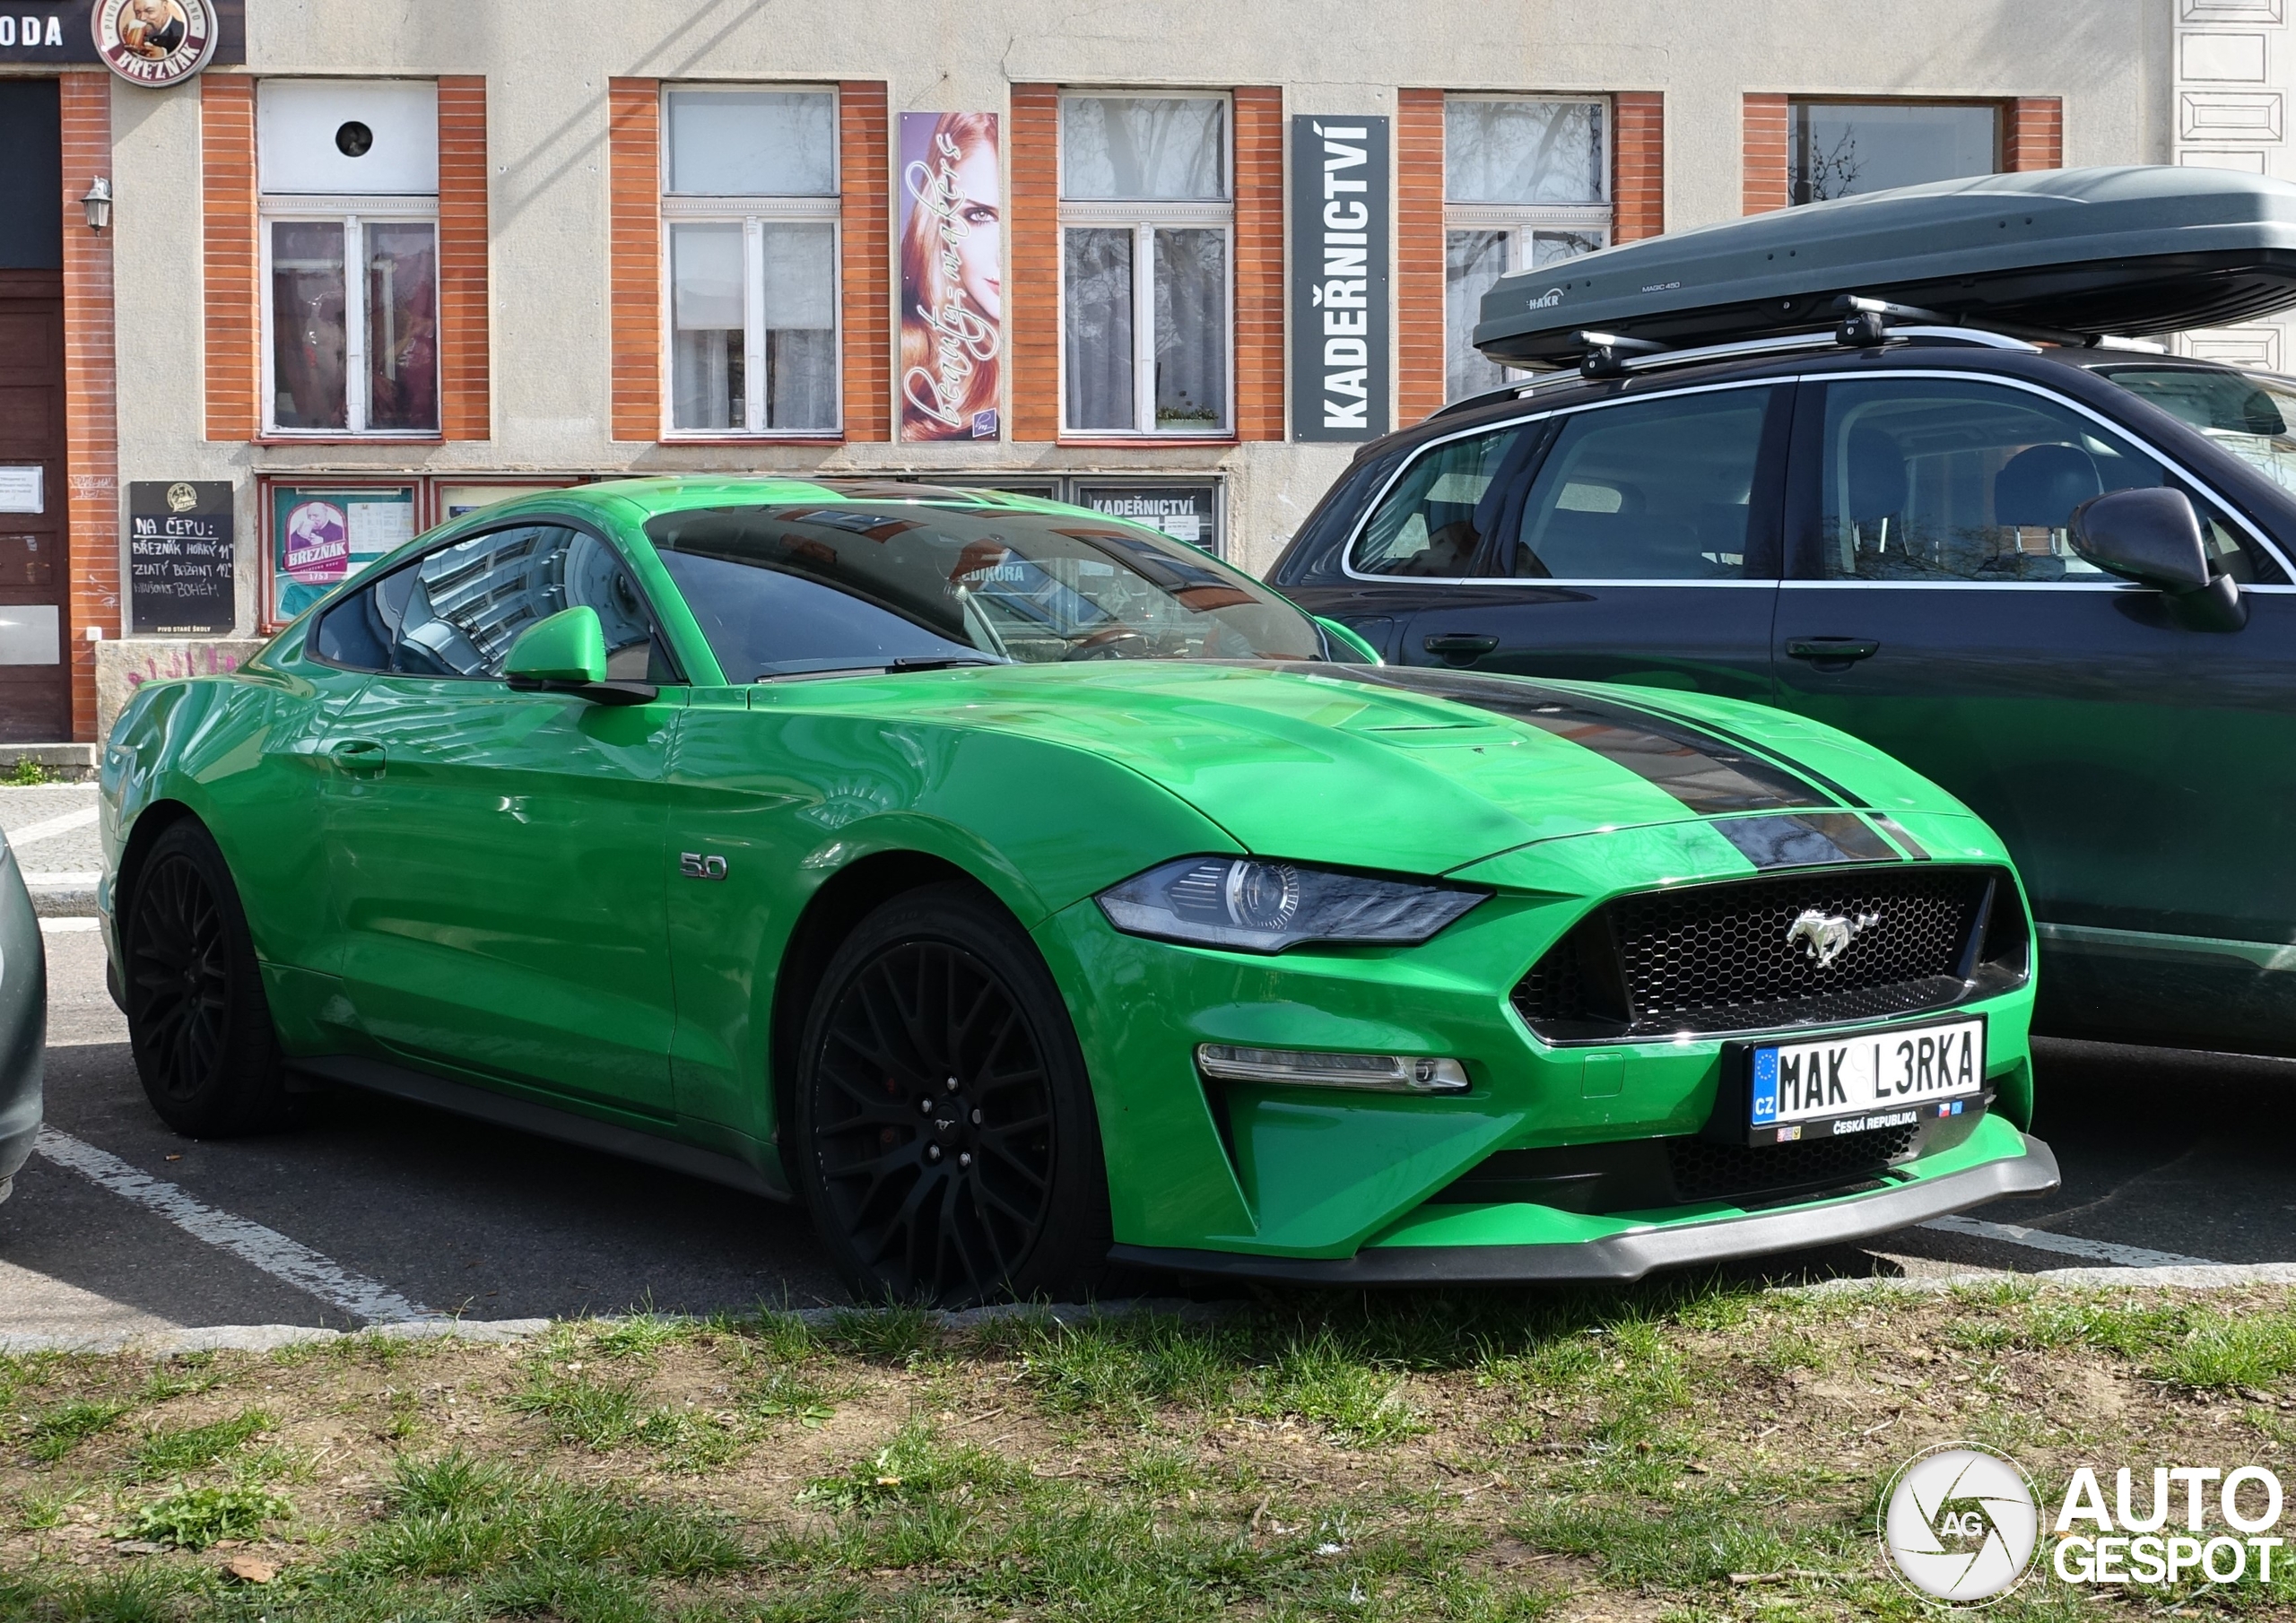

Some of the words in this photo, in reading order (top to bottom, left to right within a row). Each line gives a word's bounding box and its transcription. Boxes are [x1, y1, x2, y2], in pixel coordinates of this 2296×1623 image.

[0, 15, 63, 47] ODA
[1313, 120, 1369, 429] KADEŘNICTVÍ
[1641, 283, 1665, 293] MAGIC
[1665, 282, 1681, 290] 450
[1529, 294, 1559, 310] HAKR
[1092, 495, 1196, 516] KADEŘNICTVÍ
[135, 517, 157, 535] NA
[132, 560, 170, 577] ZLATÝ
[172, 561, 213, 577] BAŽANT
[1779, 1046, 1848, 1114] MAK
[1874, 1030, 1973, 1099] L3RKA
[1754, 1097, 1774, 1115] CZ
[1832, 1116, 1866, 1135] ČESKÁ
[1866, 1110, 1918, 1131] REPUBLIKA
